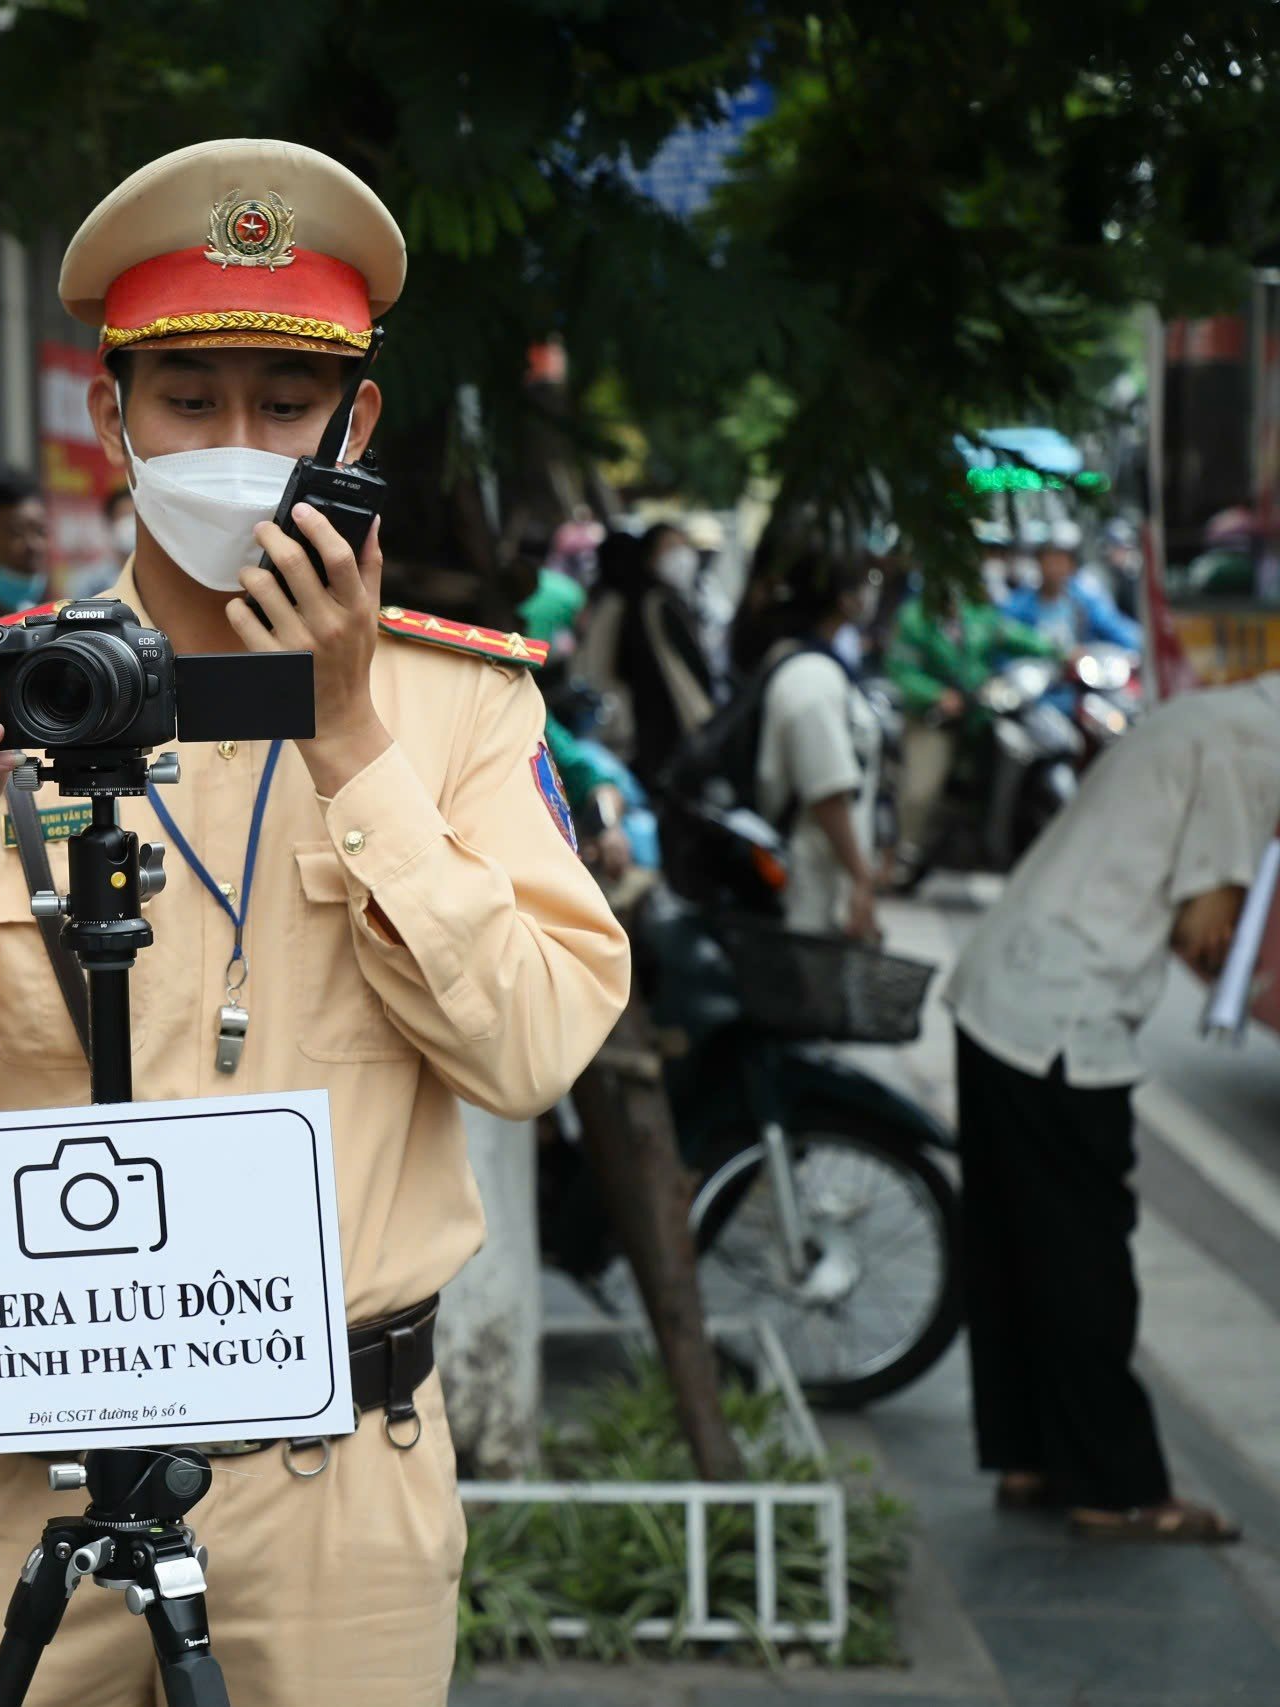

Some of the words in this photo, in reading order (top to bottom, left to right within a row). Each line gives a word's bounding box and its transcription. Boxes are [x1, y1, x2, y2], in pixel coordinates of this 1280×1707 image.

[65, 610, 105, 619] Canon
[138, 637, 155, 645] EOS
[142, 650, 158, 658] R10
[86, 1281, 165, 1323] LƯU
[177, 1270, 293, 1324] ĐỘNG
[80, 1344, 176, 1379] PHẠT
[186, 1328, 306, 1370] NGUỘI
[29, 1411, 52, 1426] Đội
[57, 1410, 96, 1422] CSGT
[98, 1407, 139, 1422] đường
[143, 1406, 157, 1419] bộ
[162, 1403, 176, 1416] số
[179, 1404, 186, 1415] 6
